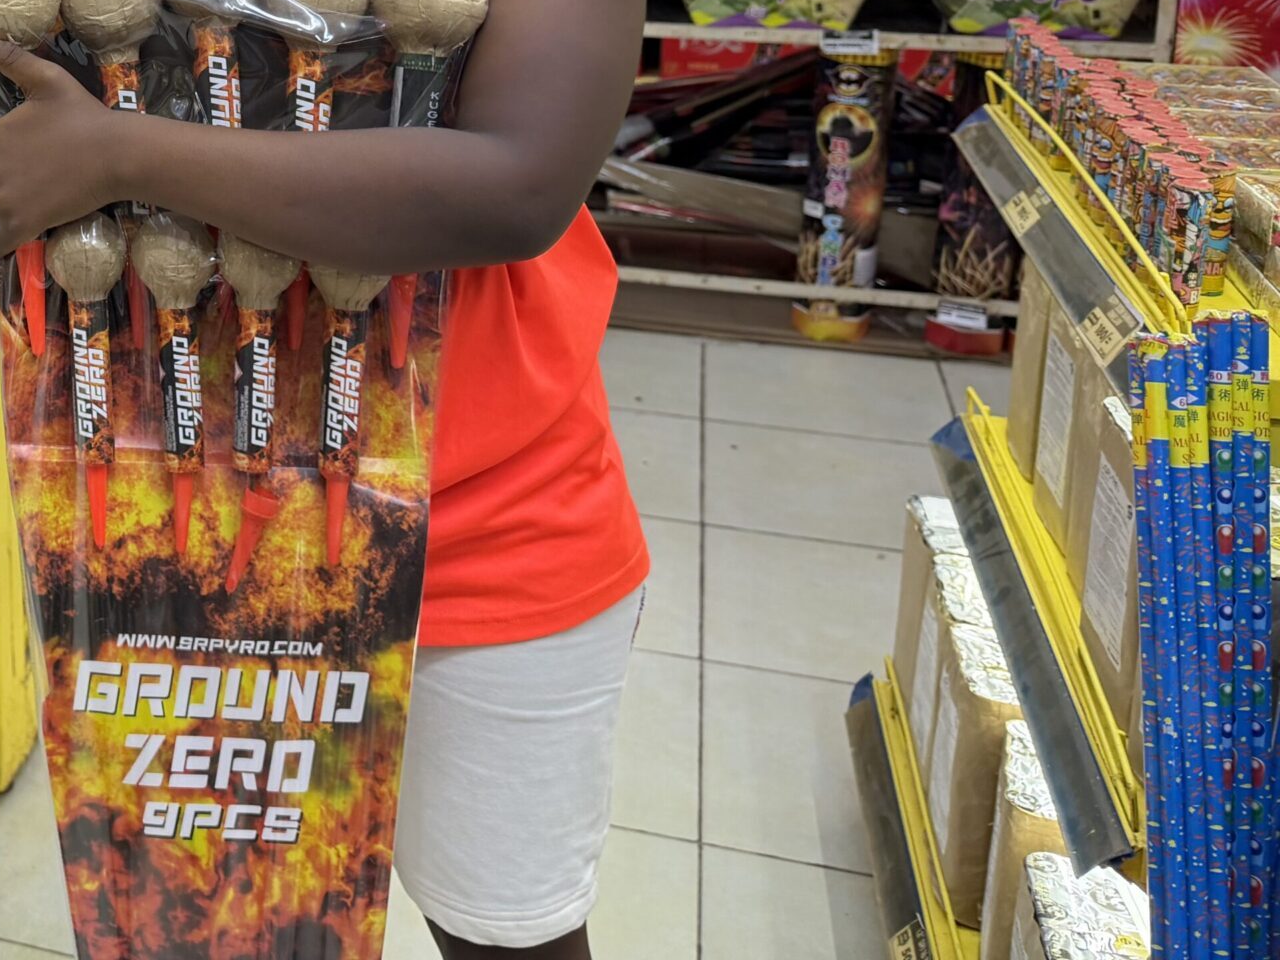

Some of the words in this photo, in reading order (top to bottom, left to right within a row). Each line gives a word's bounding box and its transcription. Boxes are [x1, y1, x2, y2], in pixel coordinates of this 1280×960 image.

[73, 327, 94, 439] GROUND
[86, 347, 109, 424] ZERO
[172, 335, 196, 446] GROUND
[250, 336, 270, 447] GROUND
[325, 335, 348, 450] GROUND
[342, 358, 362, 433] ZERO
[116, 633, 323, 657] WWW.SRPYRO.COM
[72, 659, 370, 725] GROUND
[122, 733, 317, 794] ZERO
